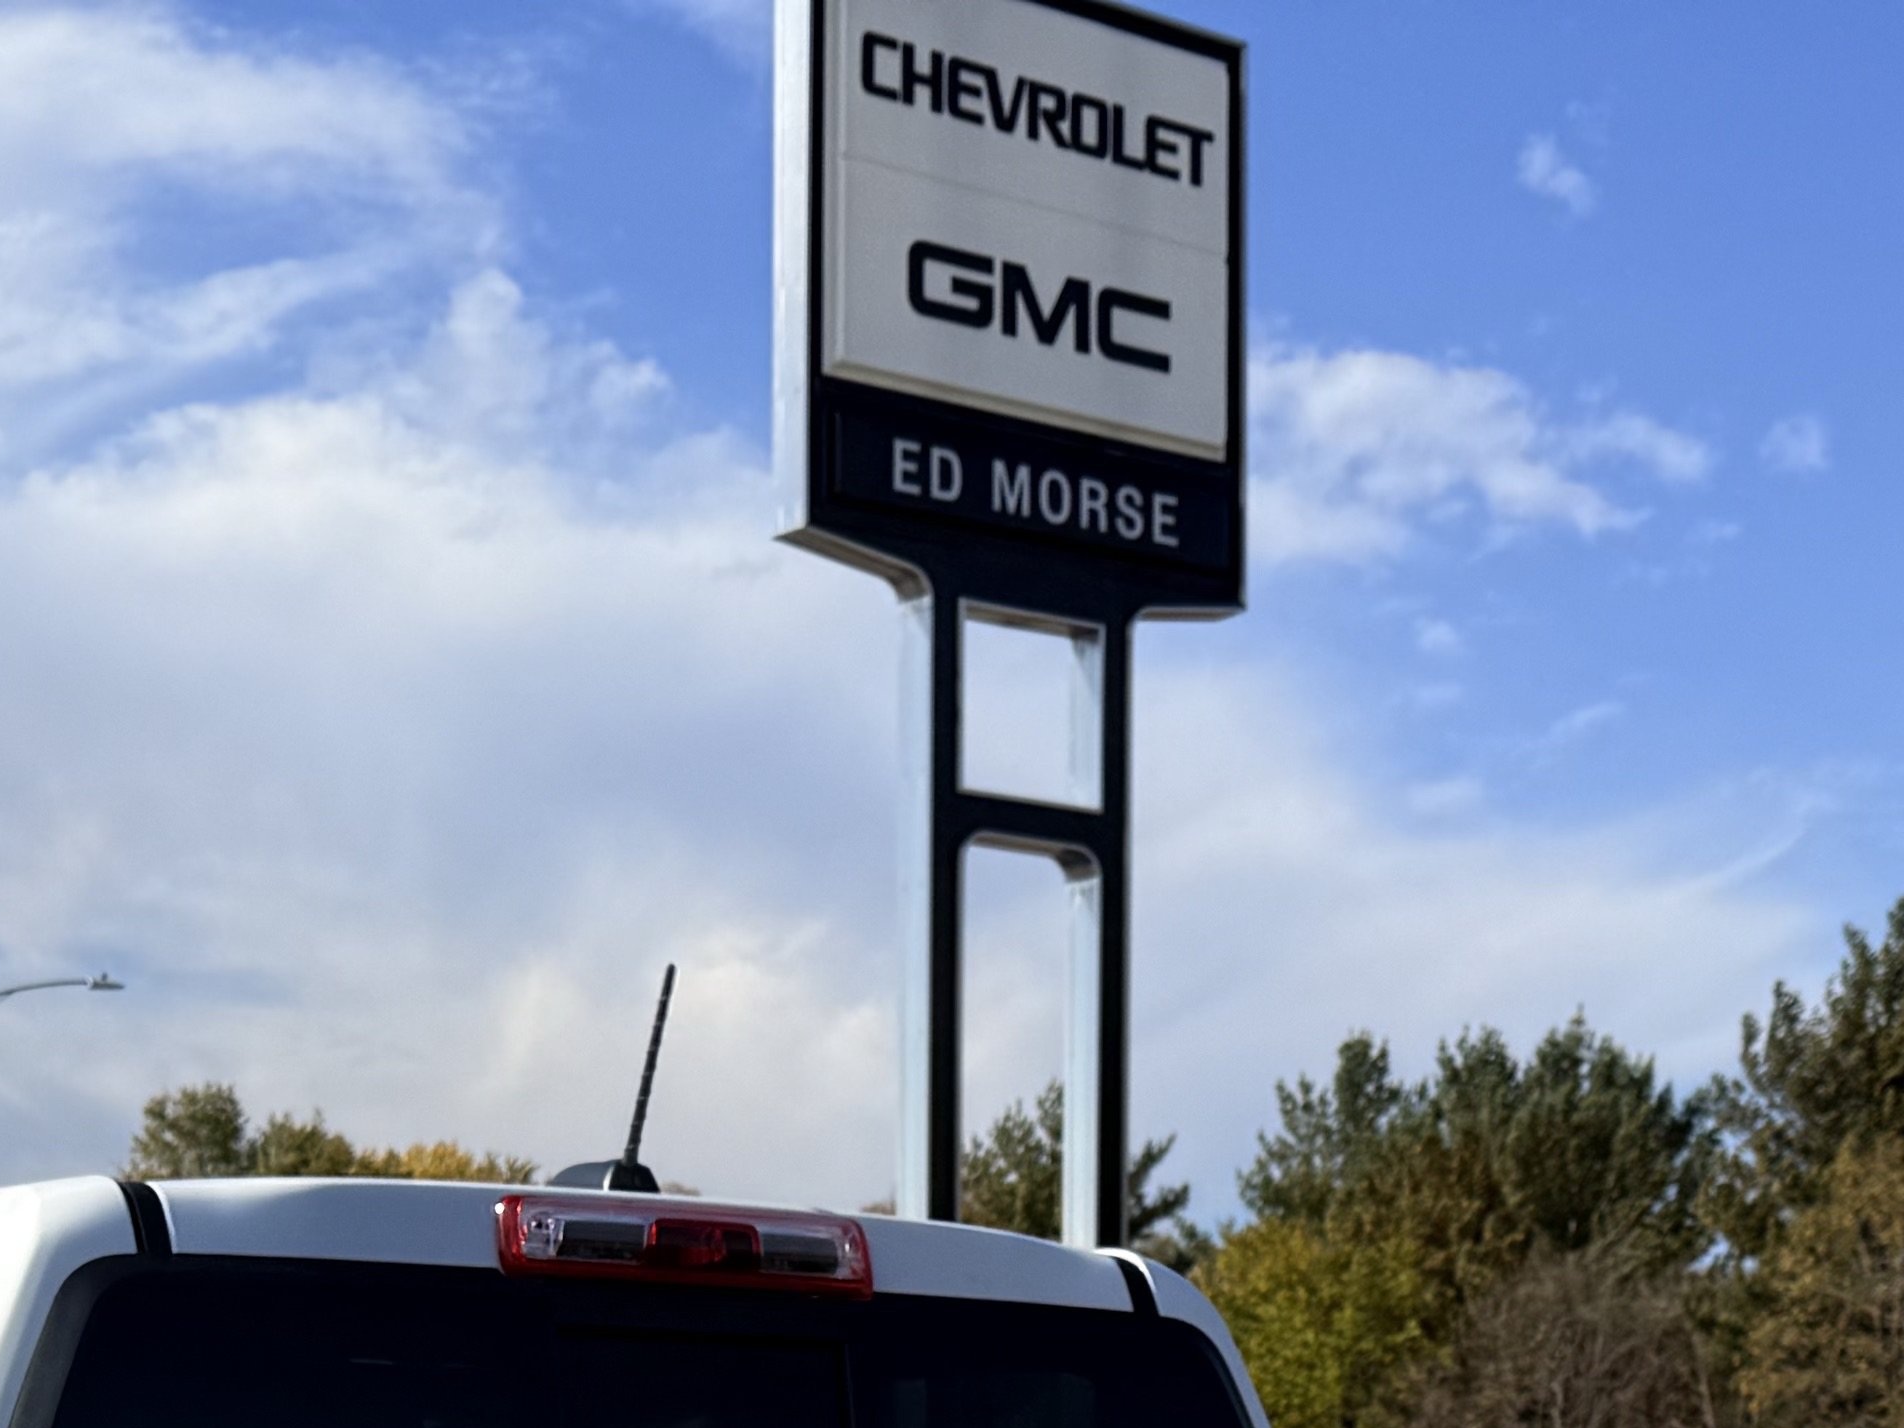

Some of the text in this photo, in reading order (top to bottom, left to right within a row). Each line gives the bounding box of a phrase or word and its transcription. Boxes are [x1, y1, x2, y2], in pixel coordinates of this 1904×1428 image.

[860, 29, 1216, 188] CHEVROLET
[906, 238, 1171, 375] GMC
[891, 436, 1180, 548] ED MORSE
